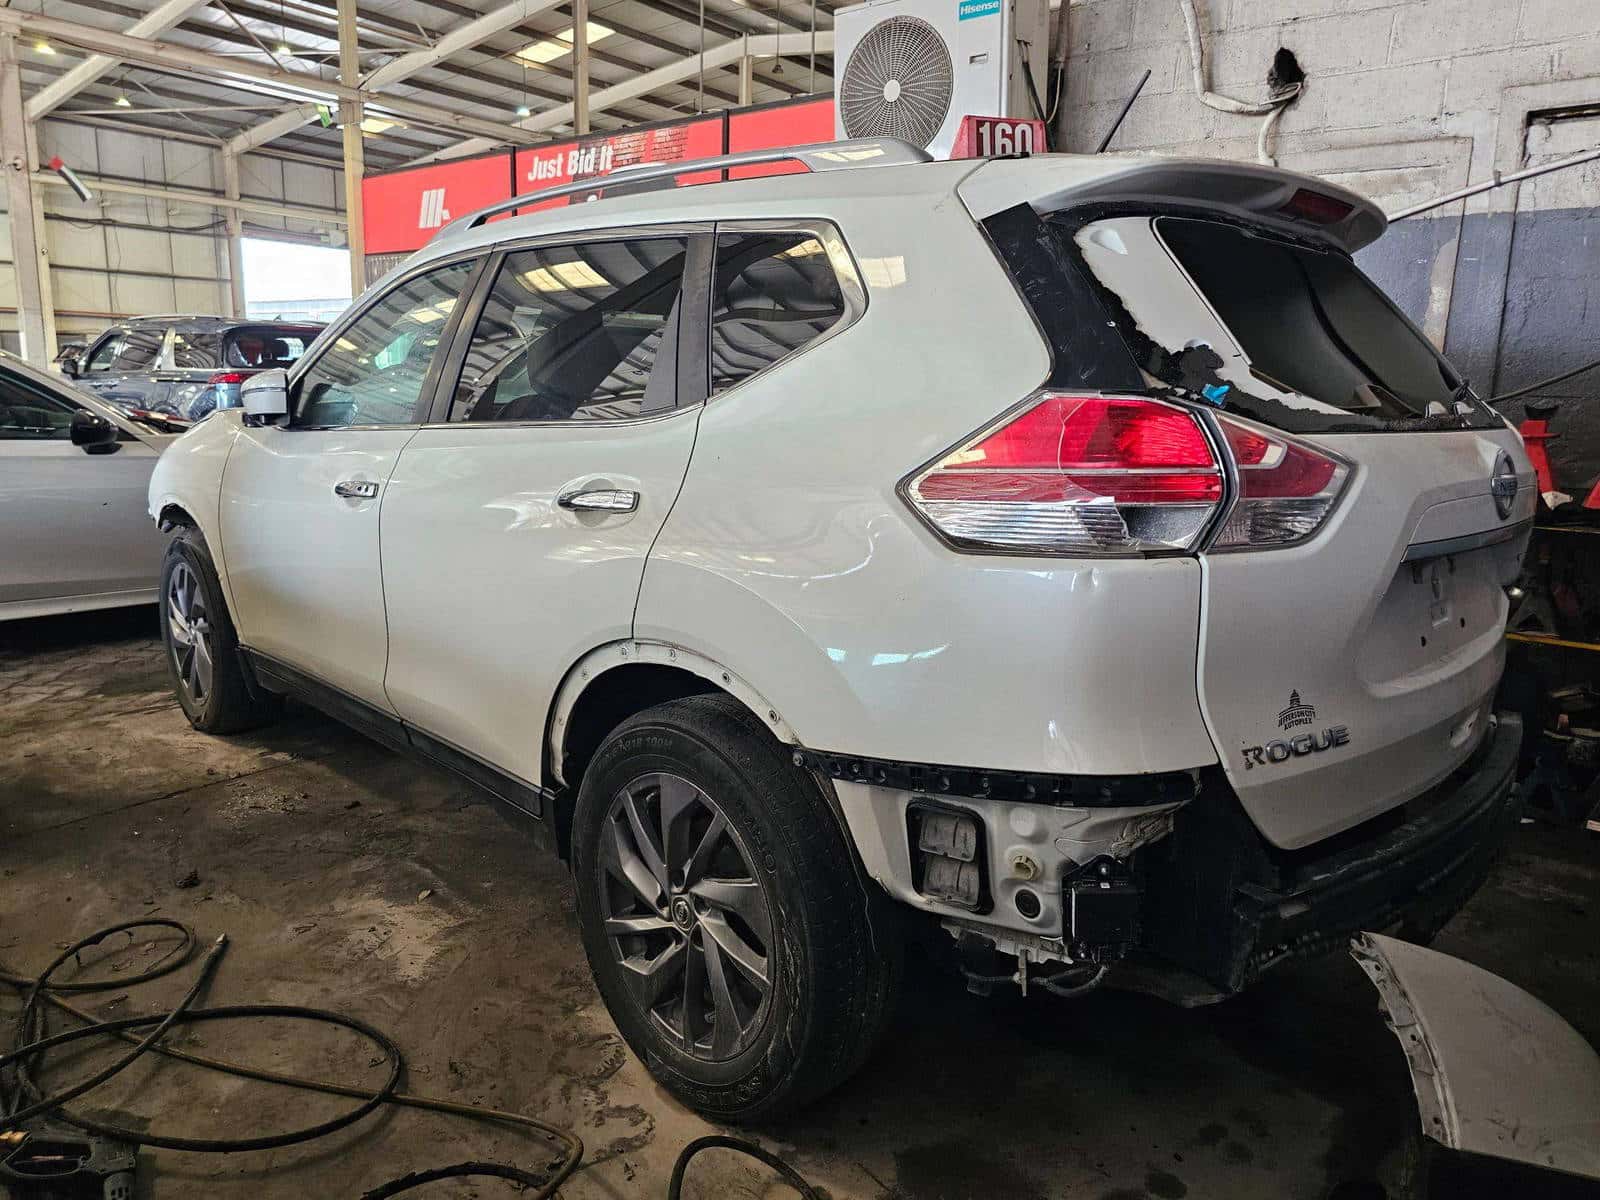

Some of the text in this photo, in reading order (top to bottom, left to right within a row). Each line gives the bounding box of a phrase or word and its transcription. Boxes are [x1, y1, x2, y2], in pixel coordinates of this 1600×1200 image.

[959, 1, 1000, 16] Hisense
[978, 121, 1034, 157] 160
[527, 152, 564, 182] Just
[567, 147, 596, 176] Bid
[599, 144, 614, 171] It
[1242, 725, 1350, 769] ROGUE
